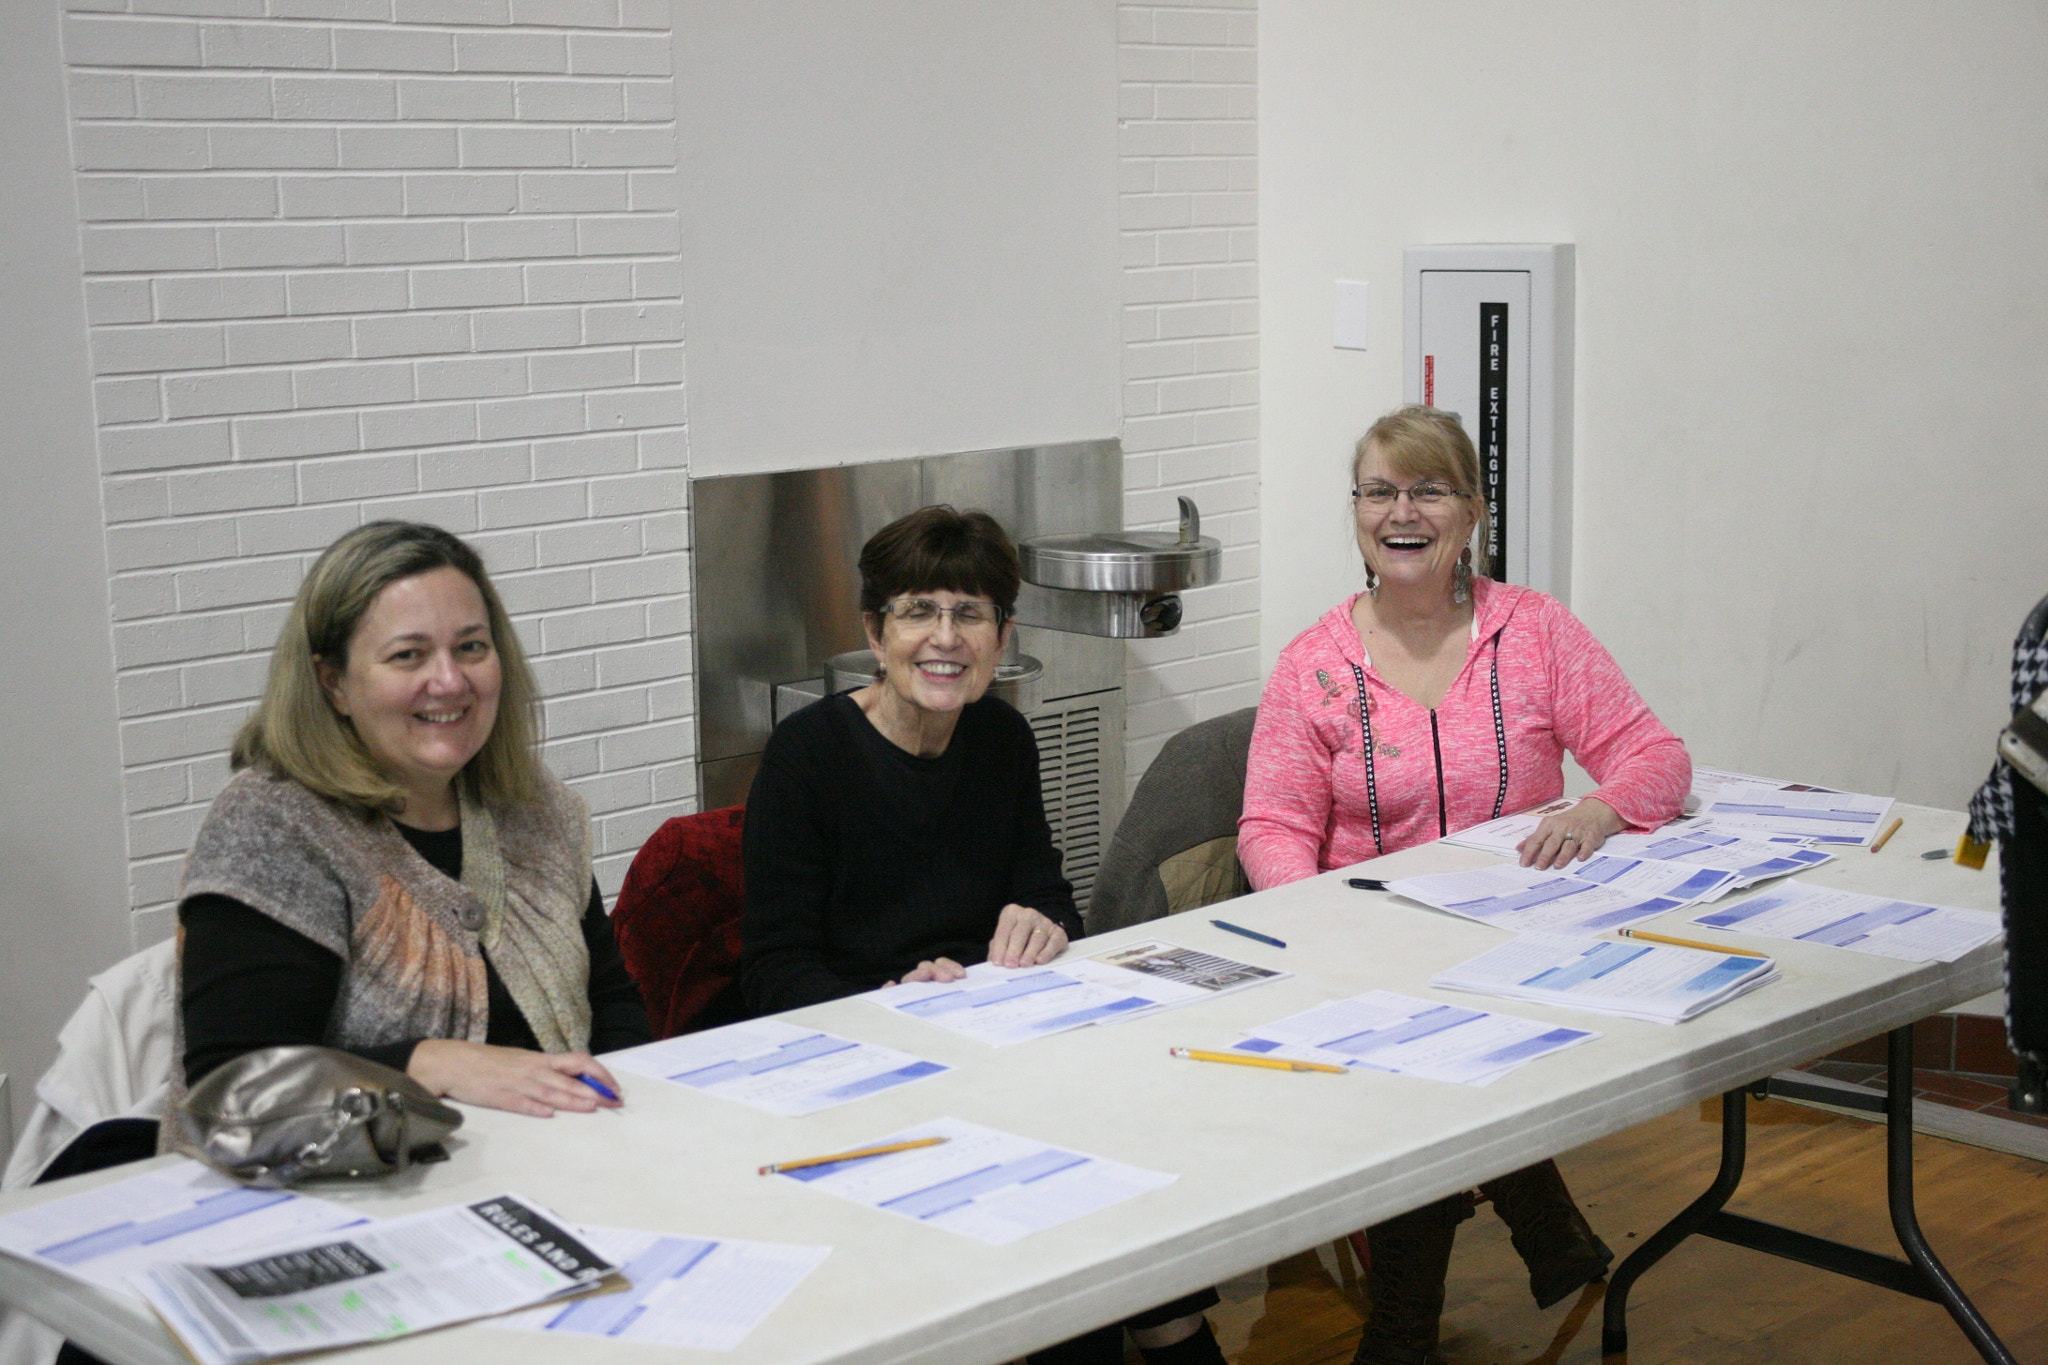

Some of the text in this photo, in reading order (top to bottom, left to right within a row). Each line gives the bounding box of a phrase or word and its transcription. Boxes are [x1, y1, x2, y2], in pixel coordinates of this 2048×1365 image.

[1488, 314, 1500, 557] FIRE EXTINGUISHER
[478, 1202, 542, 1244] RULES
[533, 1240, 581, 1272] AND
